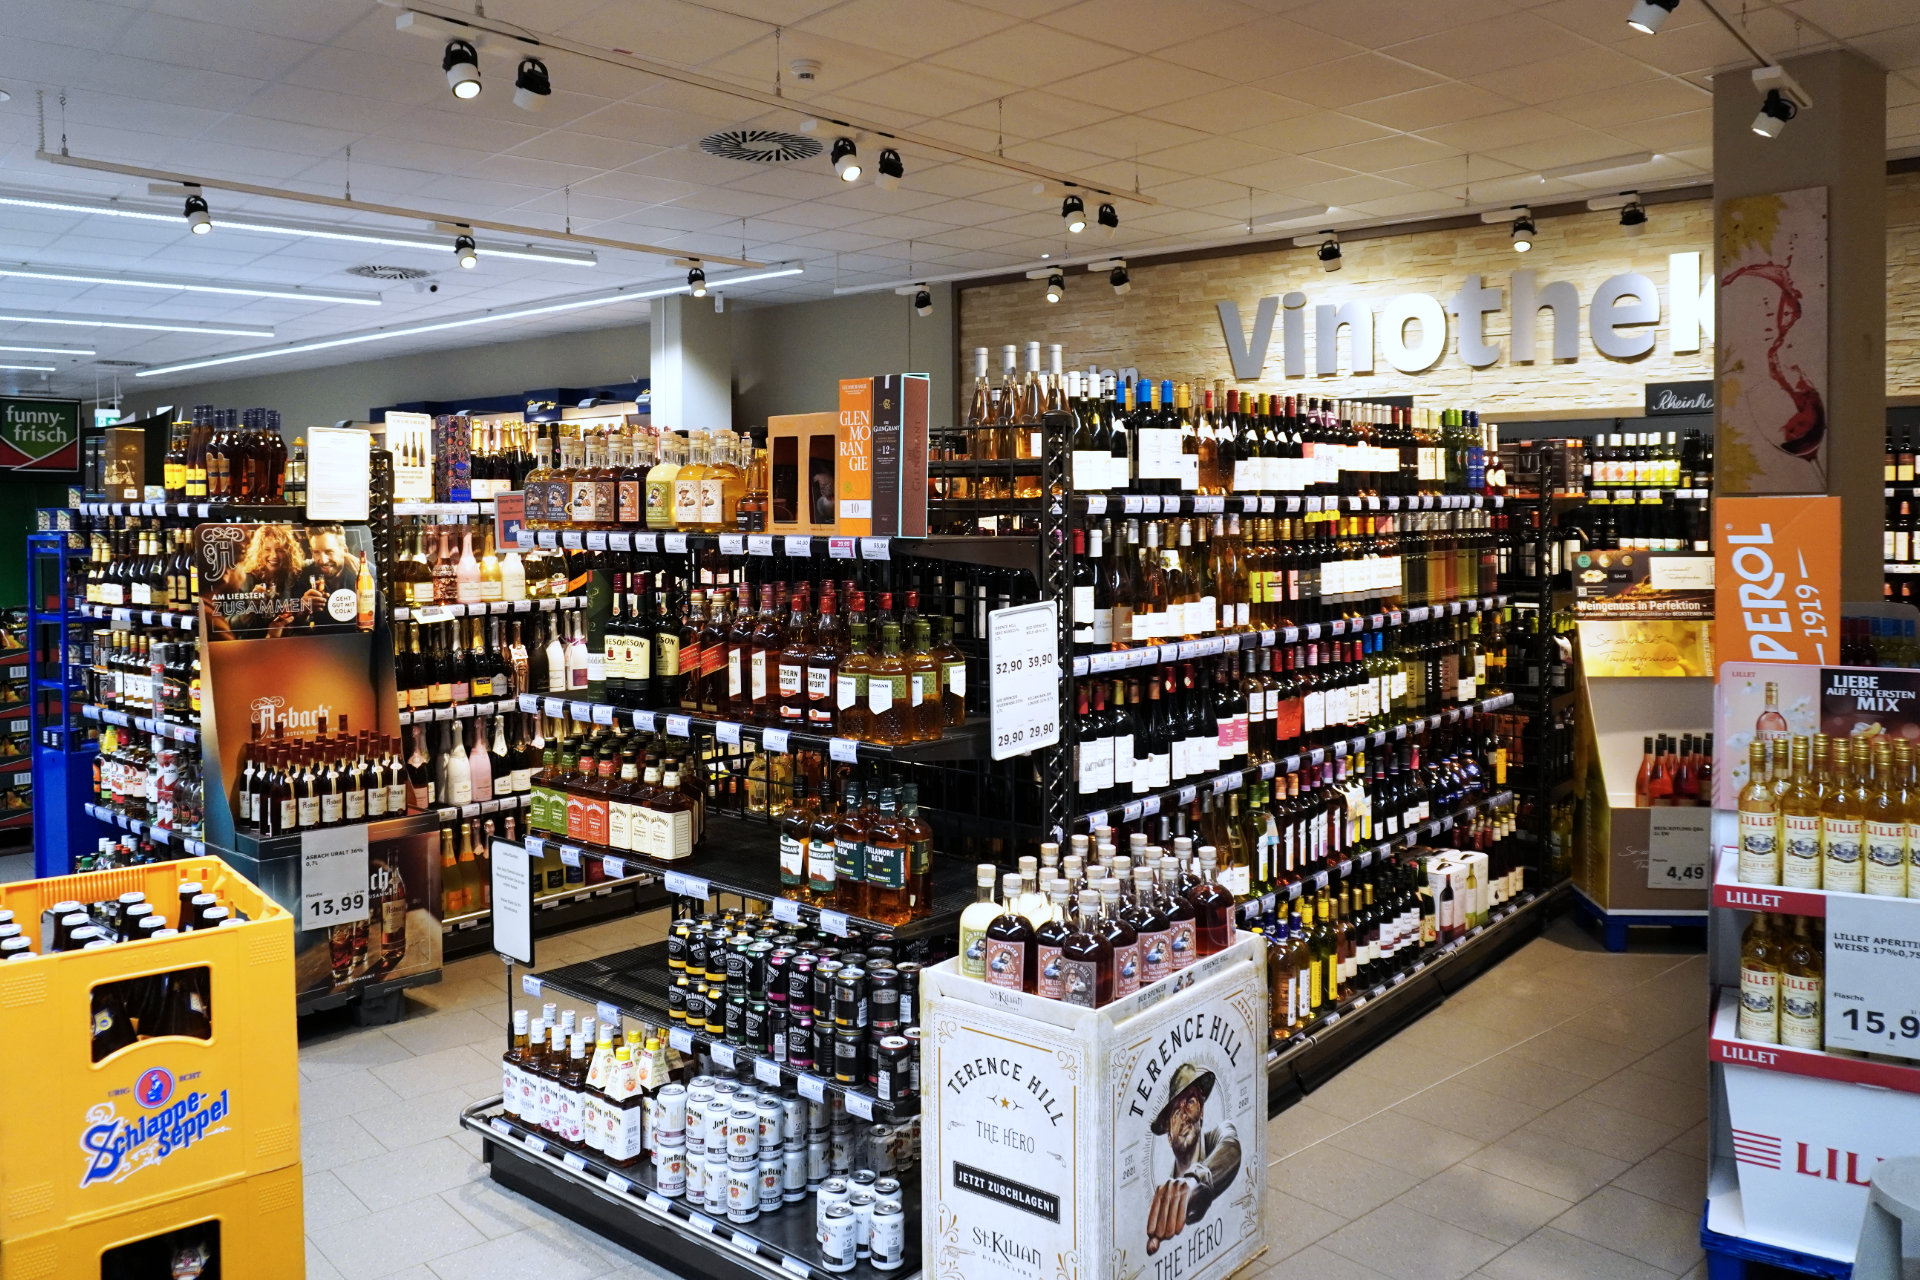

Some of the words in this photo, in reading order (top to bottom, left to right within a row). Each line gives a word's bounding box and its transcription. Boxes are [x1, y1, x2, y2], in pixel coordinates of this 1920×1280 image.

[1652, 389, 1715, 411] Rheinhe
[6, 405, 66, 428] funny-
[840, 410, 870, 426] GLEN
[13, 423, 68, 443] frisch
[850, 425, 872, 441] MO
[840, 441, 863, 456] RAN
[882, 445, 890, 455] 12
[849, 456, 869, 472] GIE
[851, 503, 859, 514] 10
[211, 593, 226, 601] AM
[227, 592, 265, 601] LIEBSTEN
[1727, 523, 1799, 660] PEROL
[1795, 584, 1828, 638] 1919
[212, 598, 313, 617] ZUSAMMEN
[344, 601, 356, 609] MIT
[1577, 601, 1636, 613] Weingenuss
[1638, 600, 1648, 611] in
[1649, 600, 1701, 611] Perfektion
[996, 659, 1023, 675] 32,90
[1028, 653, 1053, 668] 39,90
[1833, 674, 1879, 689] LIEBE
[1826, 688, 1848, 697] AUF
[1851, 688, 1874, 697] DEN
[1876, 689, 1917, 700] ERSTEN
[1857, 696, 1900, 712] MIX
[998, 730, 1024, 747] 29,90
[1029, 722, 1054, 739] 29,90
[305, 853, 330, 861] ASBACH
[350, 847, 364, 855] 36%
[865, 846, 895, 858] TULLAMORE
[1666, 866, 1704, 881] 4,49
[369, 889, 399, 899] USAMMEN
[1725, 891, 1785, 907] LILLET
[310, 894, 365, 917] 13,99
[1833, 932, 1871, 942] LILLET
[1834, 942, 1870, 953] WEISS
[1833, 992, 1865, 1001] Flasche
[1721, 1045, 1779, 1065] LILLET
[1128, 1013, 1205, 1118] TERENCE
[1209, 1014, 1243, 1068] HILL
[947, 1057, 1023, 1095] TERENCE
[1027, 1075, 1065, 1127] HILL
[729, 1127, 740, 1136] JIM
[739, 1125, 755, 1136] BEAM
[975, 1119, 1000, 1145] THE
[1003, 1127, 1036, 1154] HERO
[82, 1091, 209, 1187] Schlappe-
[1795, 1140, 1872, 1187] LIL
[957, 1170, 986, 1189] JETZT
[987, 1180, 1055, 1215] ZUSCHLAGEN!
[1154, 1245, 1184, 1280] THE
[1187, 1217, 1223, 1268] HERO
